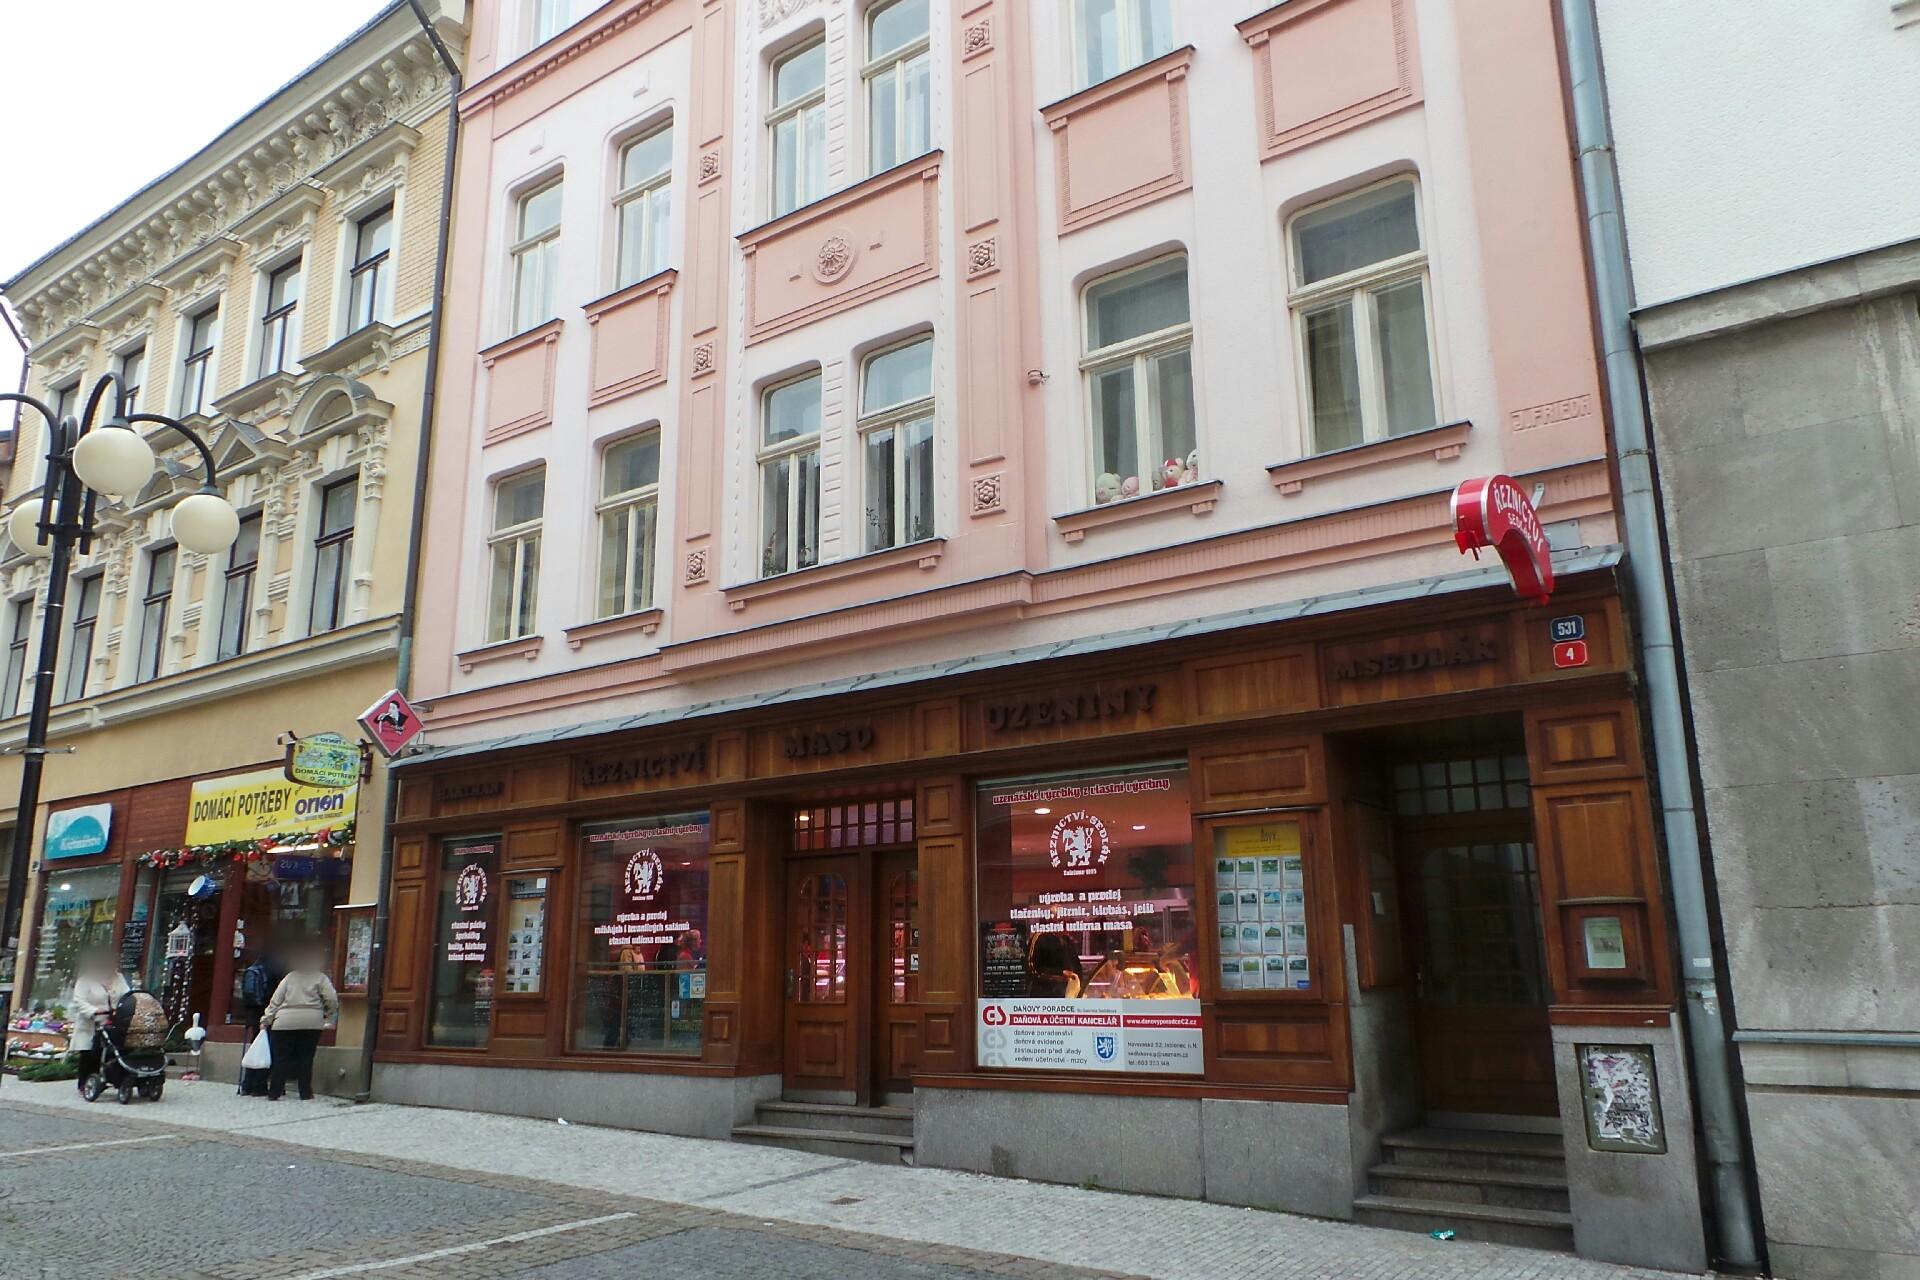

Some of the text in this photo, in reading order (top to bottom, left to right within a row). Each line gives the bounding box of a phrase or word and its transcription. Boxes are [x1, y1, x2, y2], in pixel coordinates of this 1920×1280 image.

[1557, 621, 1577, 636] 531
[1566, 647, 1575, 660] 4
[985, 684, 1160, 731] UZENINY
[784, 725, 876, 759] MASO
[1040, 786, 1081, 802] výrobky
[1083, 786, 1088, 796] z
[1090, 781, 1124, 795] vlastní
[1126, 778, 1170, 794] výrobny
[194, 785, 344, 822] DOMÁCÍ POTŘEBY orion
[1039, 888, 1121, 905] výroba a prodej
[646, 910, 667, 921] prodej
[1133, 903, 1155, 916] jelit
[1031, 920, 1133, 933] vlastní udírna masa
[1042, 1005, 1075, 1013] PORADCE
[1013, 1015, 1118, 1025] DAŇOVÁ A ÚČETNÍ KANCELÁŘ
